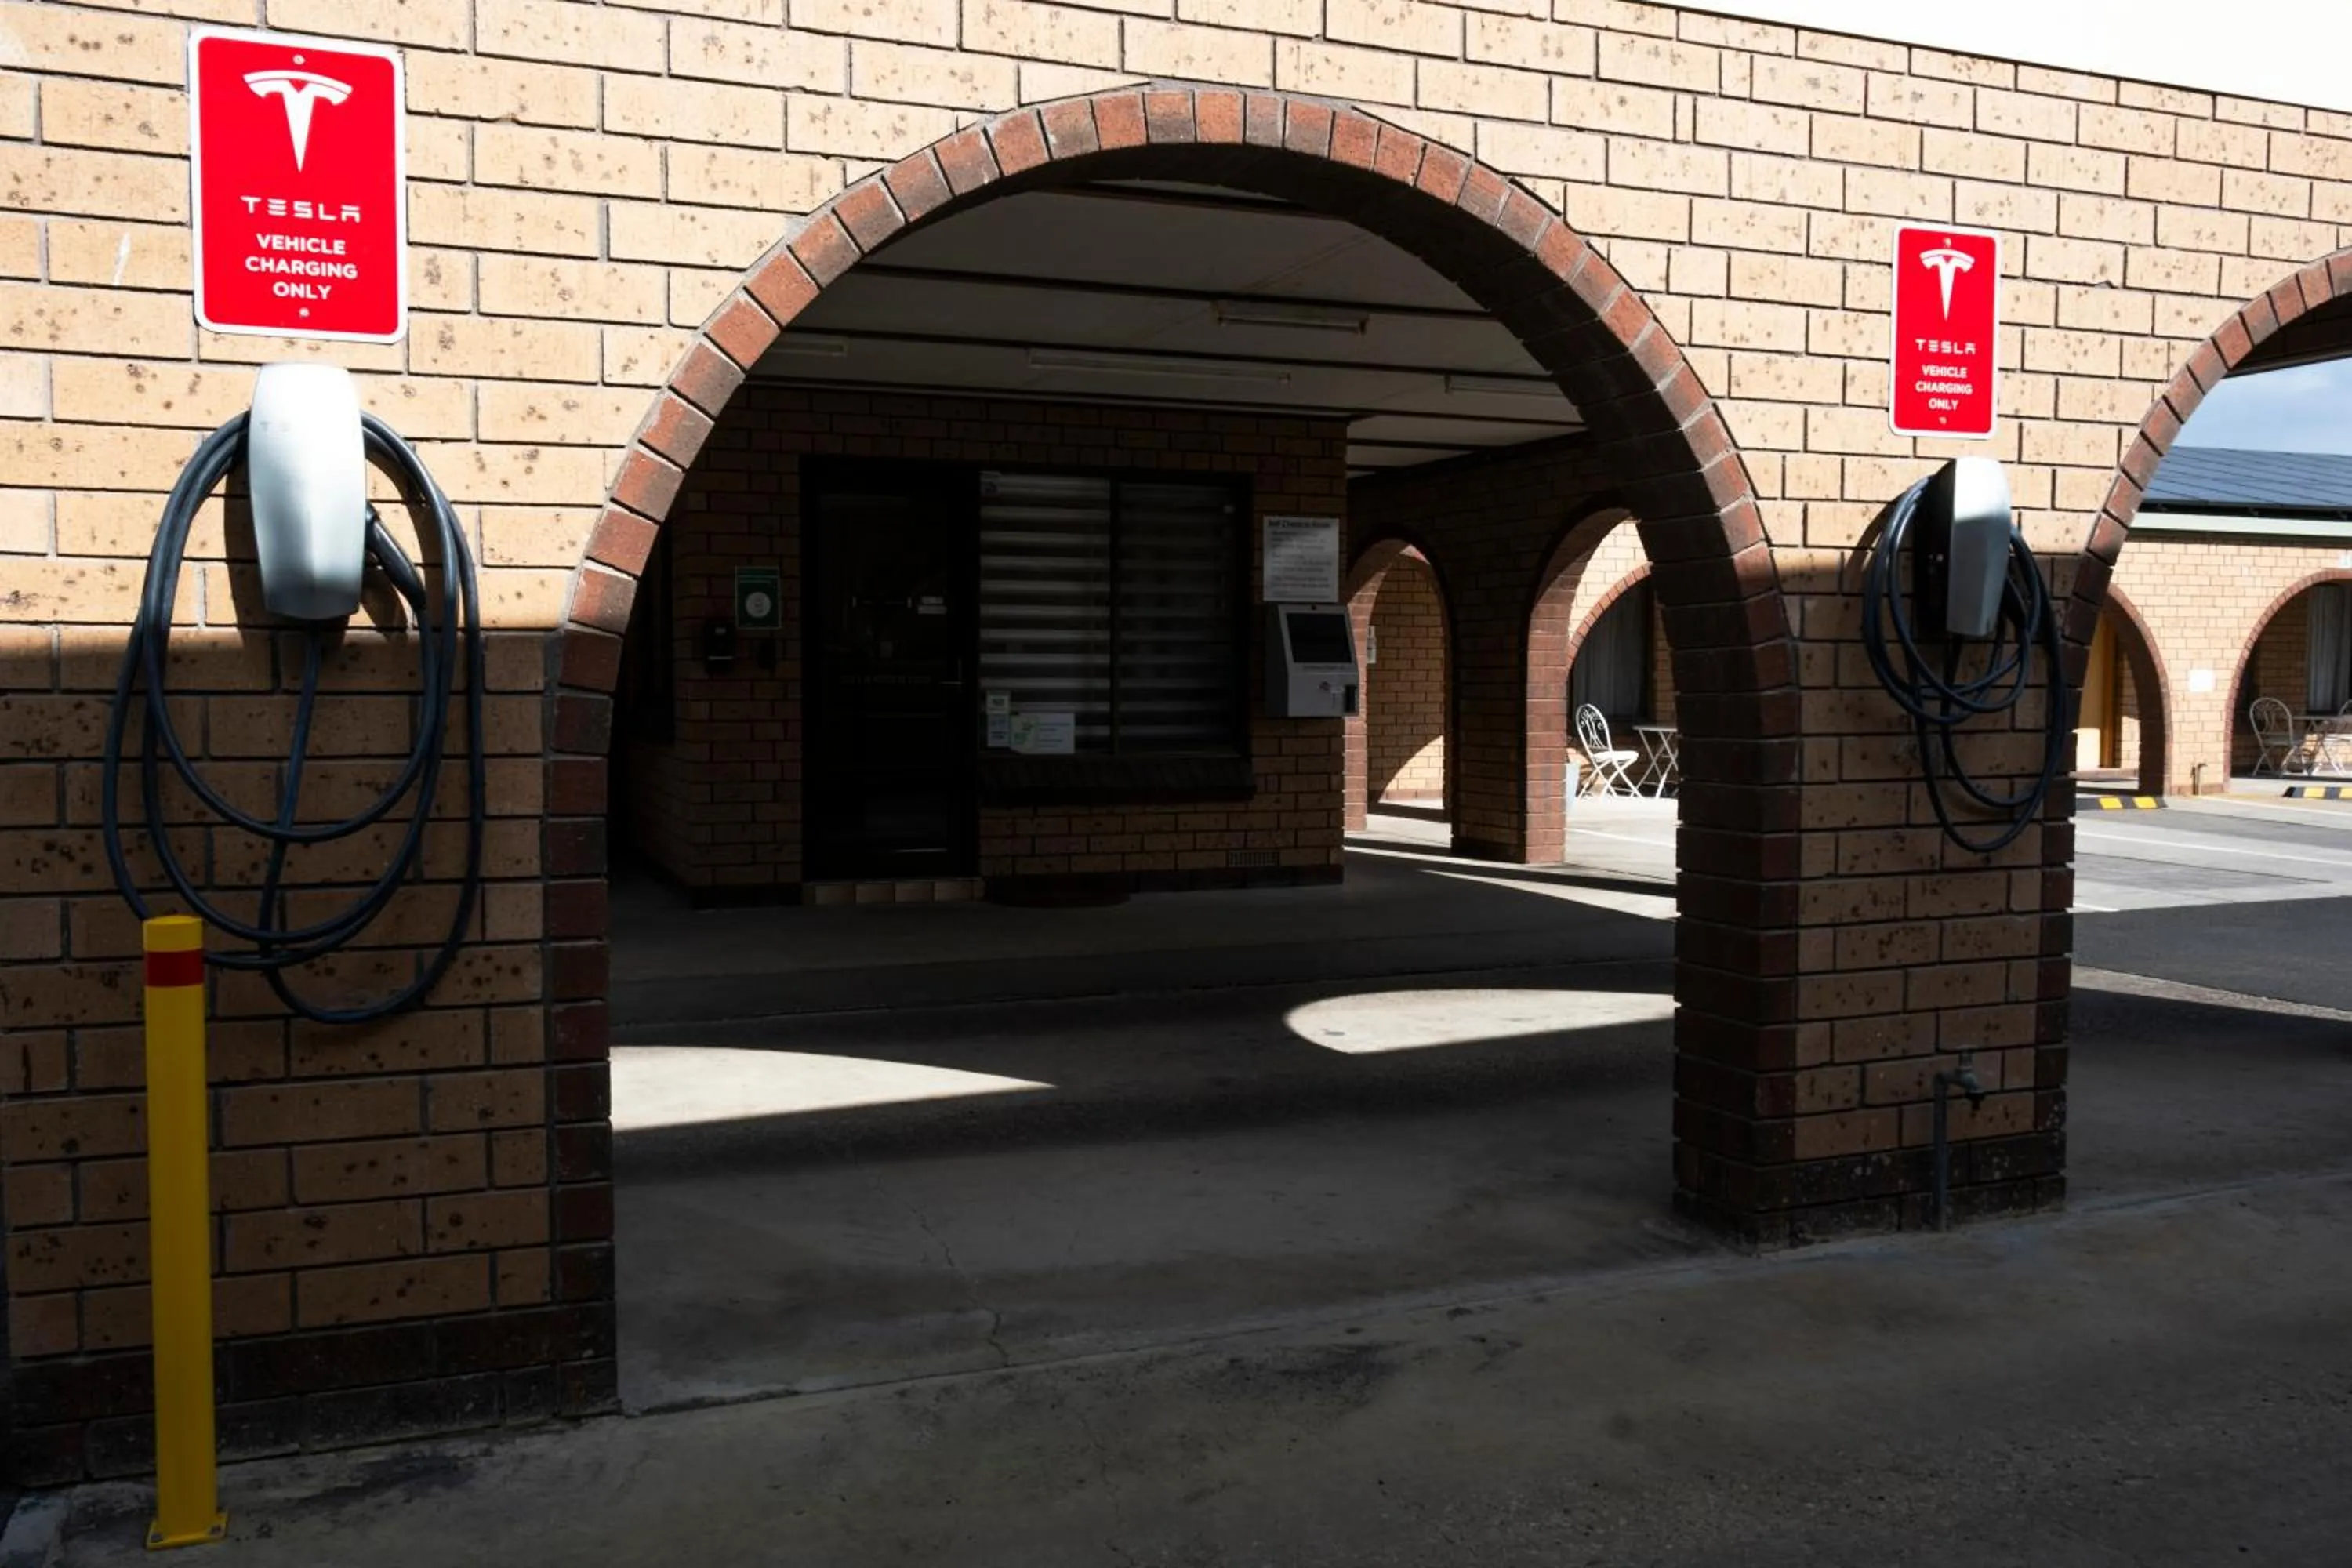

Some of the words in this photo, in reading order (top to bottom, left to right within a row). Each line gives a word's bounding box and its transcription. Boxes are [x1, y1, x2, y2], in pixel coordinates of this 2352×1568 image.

[240, 195, 361, 223] TESLA
[256, 233, 346, 256] VEHICLE
[245, 256, 358, 279] CHARGING
[272, 281, 332, 300] ONLY
[1915, 338, 1976, 354] TESLA
[1922, 365, 1968, 379] VEHICLE
[1915, 380, 1973, 395] CHARGING
[1928, 397, 1958, 411] ONLY
